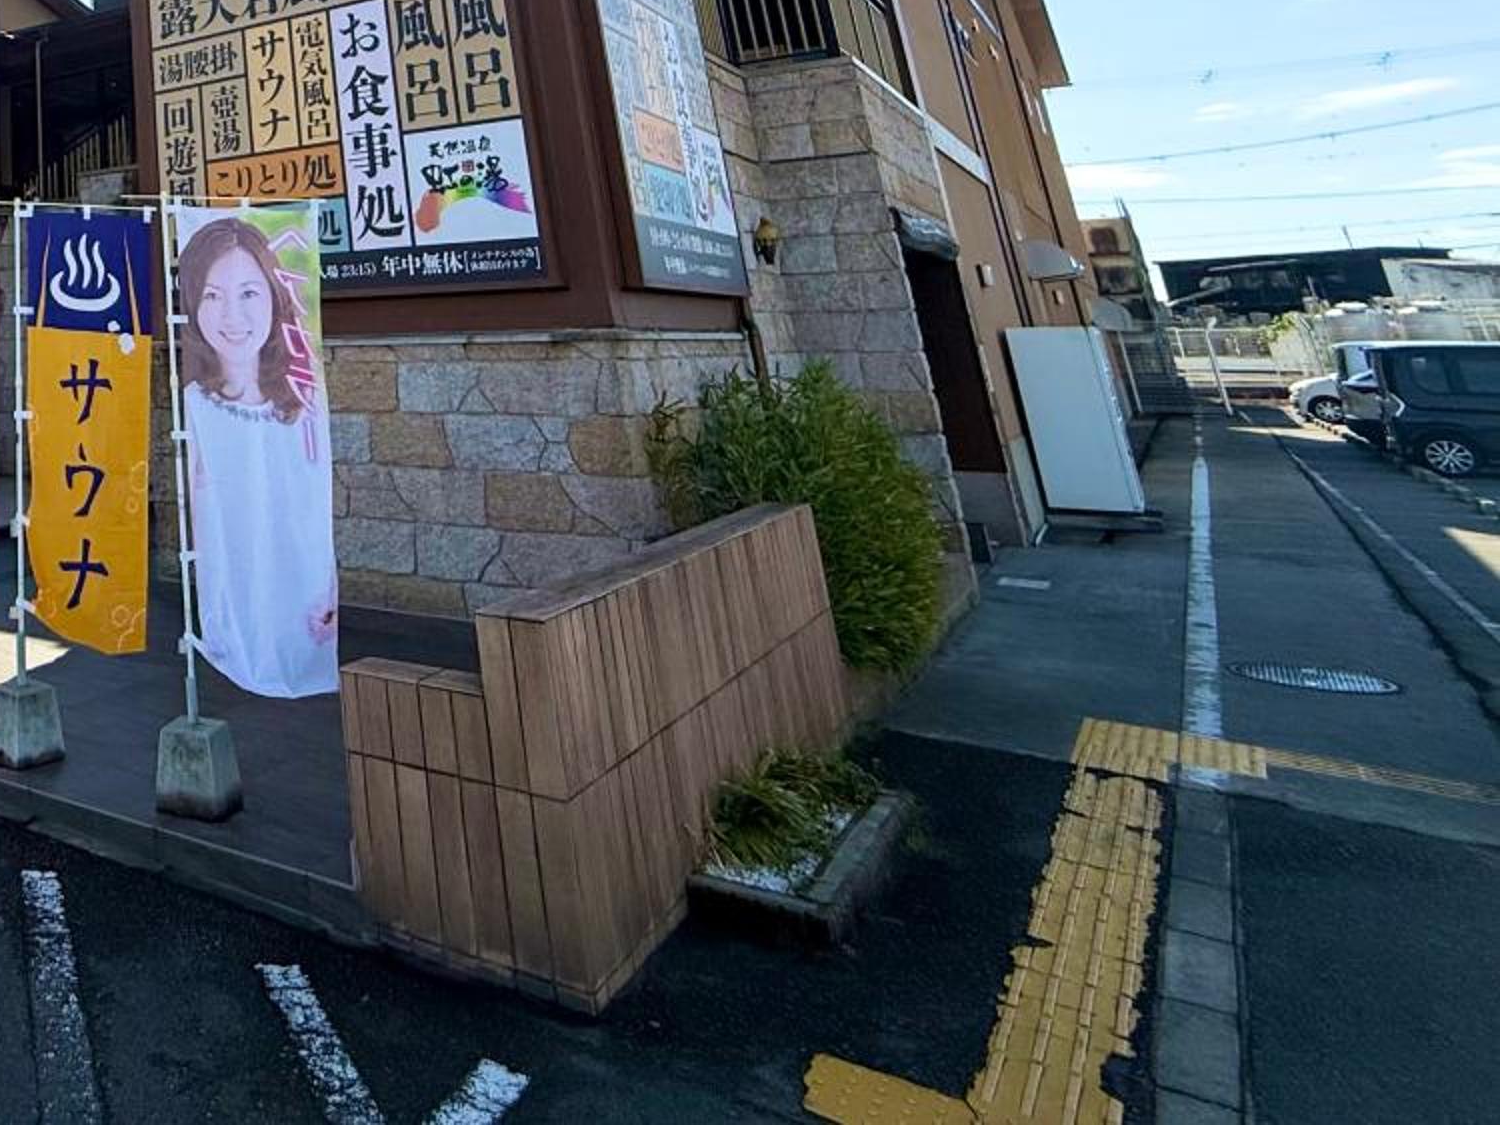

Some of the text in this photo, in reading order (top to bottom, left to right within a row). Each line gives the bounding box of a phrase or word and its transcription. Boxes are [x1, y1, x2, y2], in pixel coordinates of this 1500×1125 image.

[251, 29, 291, 147] サウナ
[295, 17, 334, 141] 電気風呂
[339, 12, 406, 243] お食事処
[214, 154, 337, 198] こりとり処
[381, 251, 463, 277] 年中無休
[59, 358, 112, 611] サウナ
